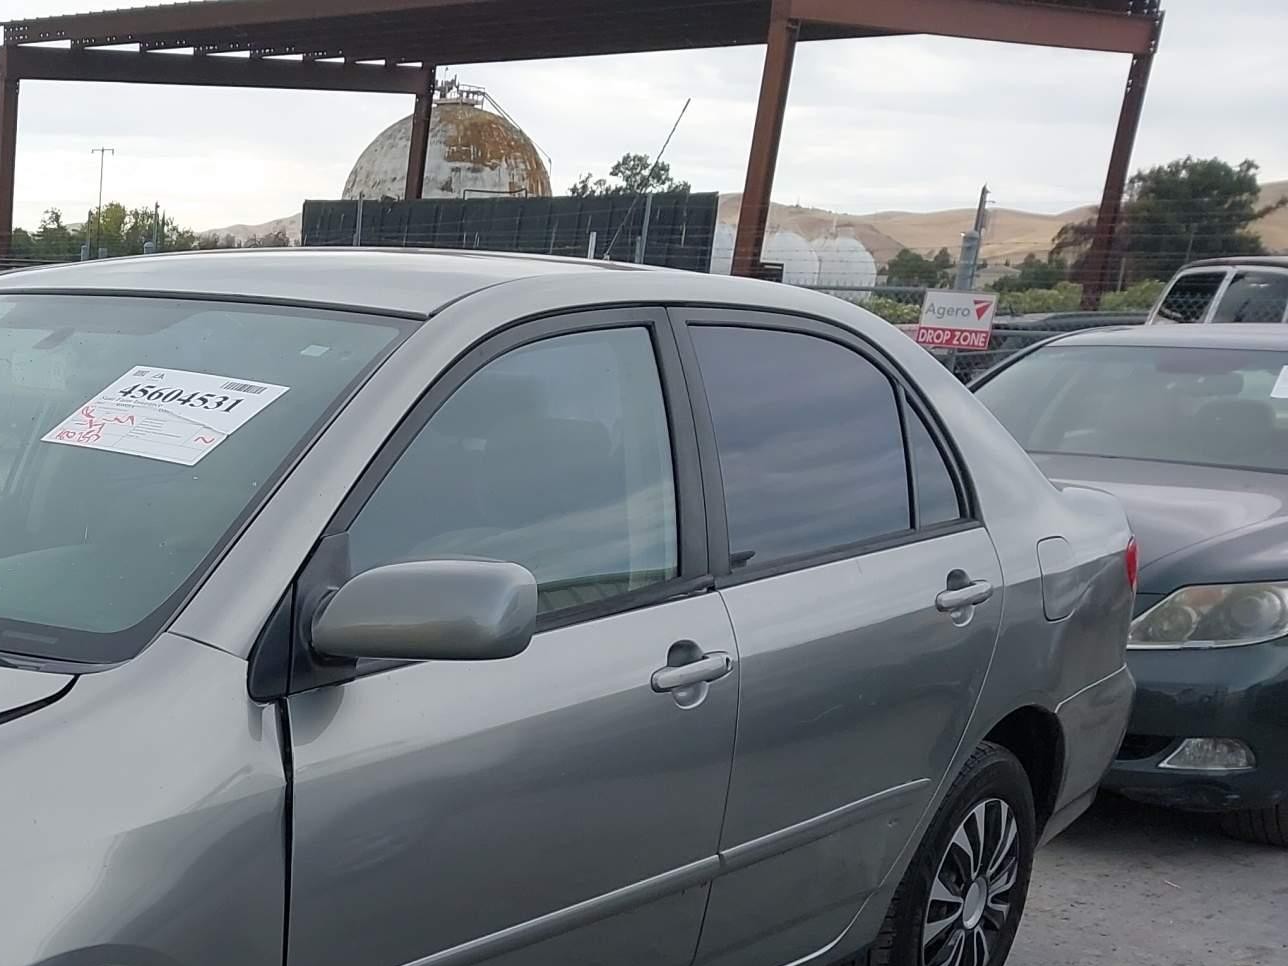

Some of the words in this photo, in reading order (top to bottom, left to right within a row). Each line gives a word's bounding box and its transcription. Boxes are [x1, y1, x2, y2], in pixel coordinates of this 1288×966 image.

[925, 303, 970, 319] Agero
[918, 328, 951, 343] DROP
[952, 331, 986, 346] ZONE
[118, 383, 245, 412] 45604531
